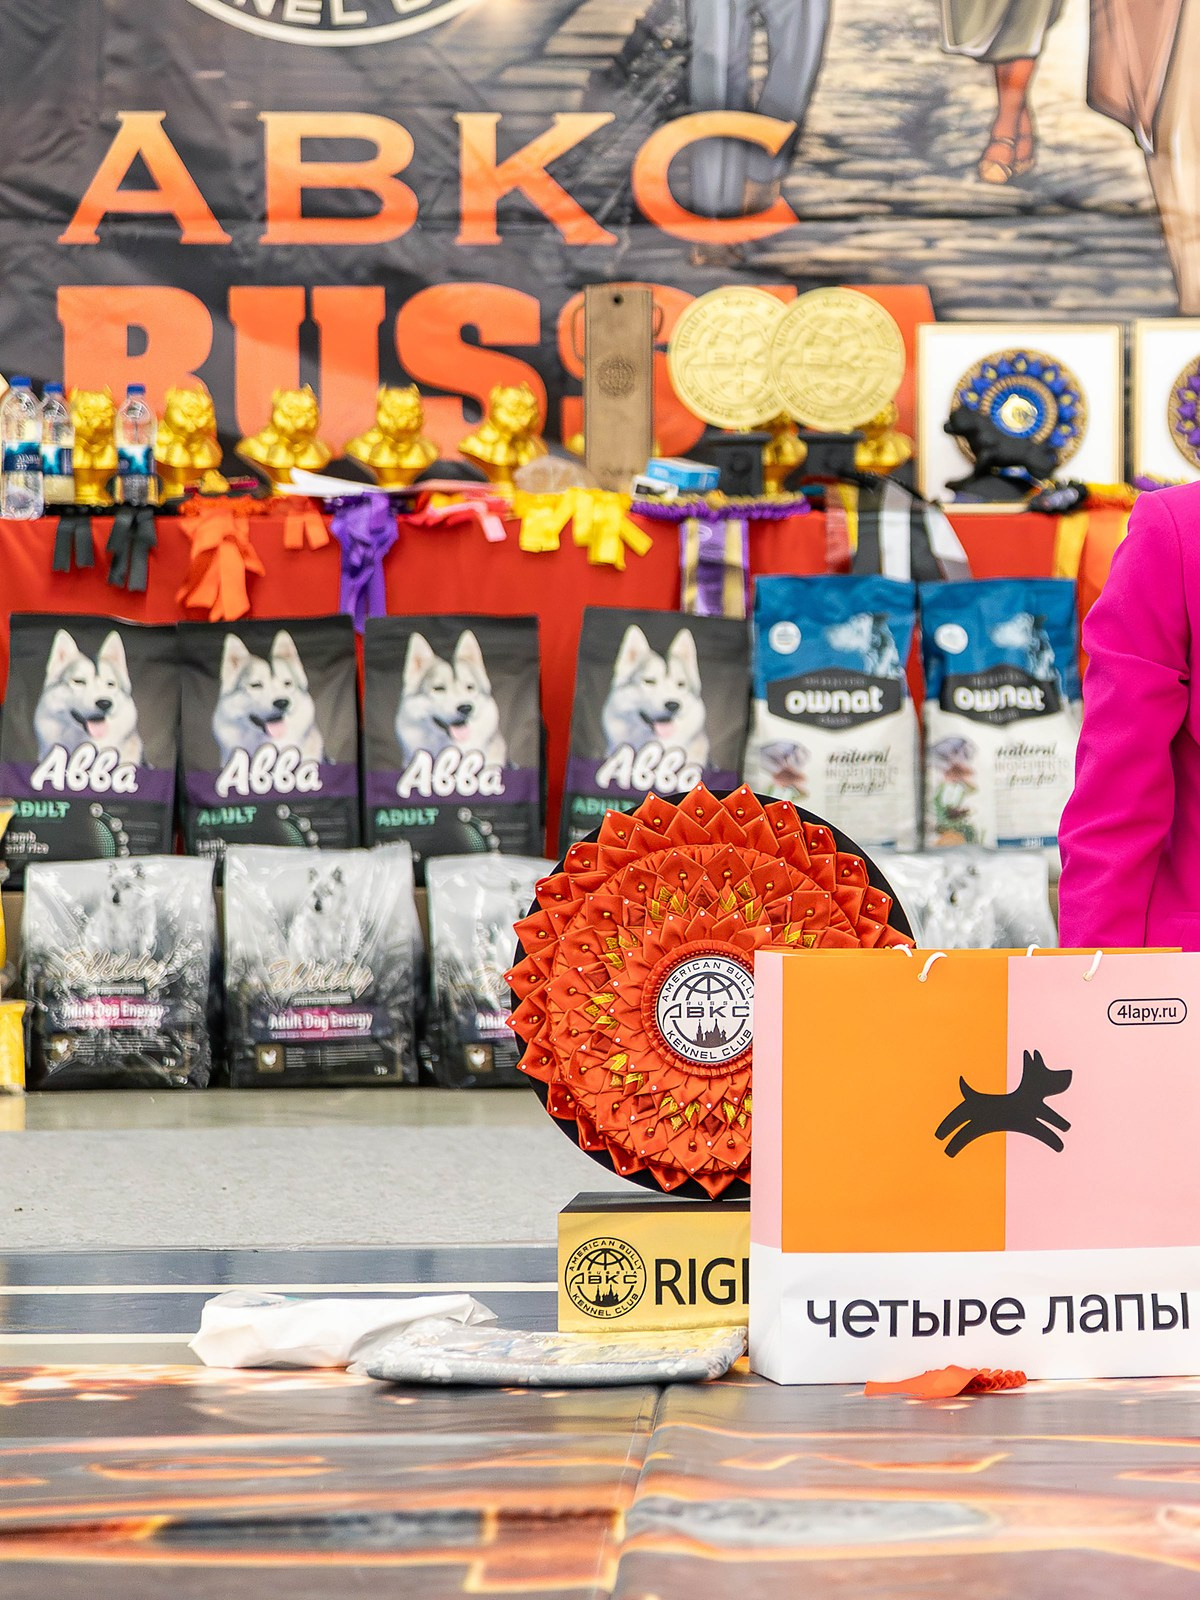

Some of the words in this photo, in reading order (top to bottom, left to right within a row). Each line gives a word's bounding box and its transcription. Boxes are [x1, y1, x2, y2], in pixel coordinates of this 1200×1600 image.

[57, 110, 800, 246] ABKC
[785, 685, 883, 714] ownat
[953, 684, 1045, 712] ownat
[30, 743, 139, 793] Abba
[216, 744, 323, 798] Abba
[397, 747, 505, 798] Abba
[198, 805, 257, 826] ADULT
[376, 808, 439, 827] ADULT
[662, 961, 721, 1002] AMERICAN
[121, 1001, 165, 1019] Energy
[268, 1013, 302, 1030] Adult
[303, 1013, 329, 1031] Dog
[330, 1012, 373, 1030] Energy
[1117, 1004, 1177, 1021] 4lapy.ru
[667, 1030, 717, 1059] KENNEL
[722, 1029, 752, 1057] CLUB
[569, 1240, 615, 1271] AMERICAN
[619, 1244, 642, 1270] BULLY
[572, 1293, 611, 1316] KENNEL
[615, 1293, 639, 1314] CLUB
[807, 1297, 1026, 1338] четыре
[1042, 1292, 1190, 1335] лапы
